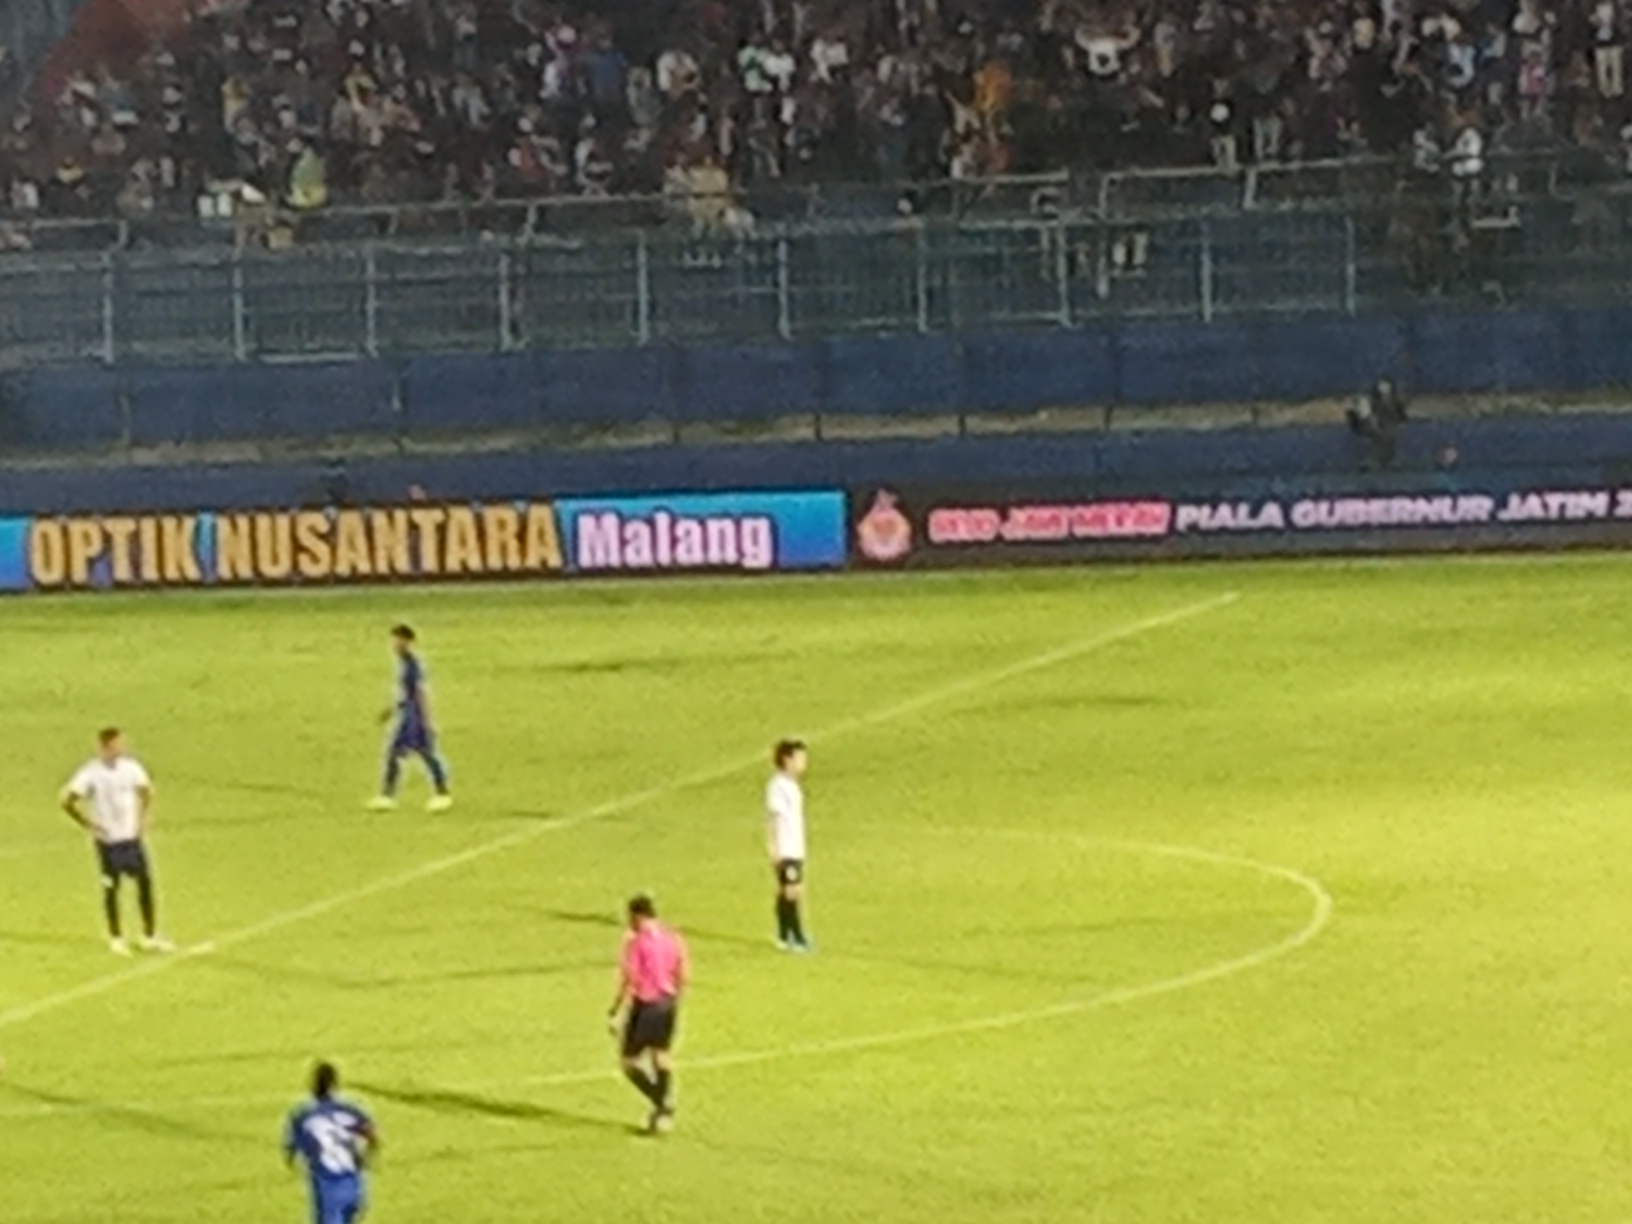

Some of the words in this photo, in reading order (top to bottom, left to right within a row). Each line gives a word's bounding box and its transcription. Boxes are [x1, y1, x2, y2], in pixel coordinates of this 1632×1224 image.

[1175, 503, 1285, 532] PIALA
[1290, 496, 1494, 528] GUBERNUR
[1496, 491, 1611, 521] JATIM
[30, 518, 200, 582] OPTIK
[217, 506, 562, 577] NUSANTARA
[579, 515, 772, 566] Malang
